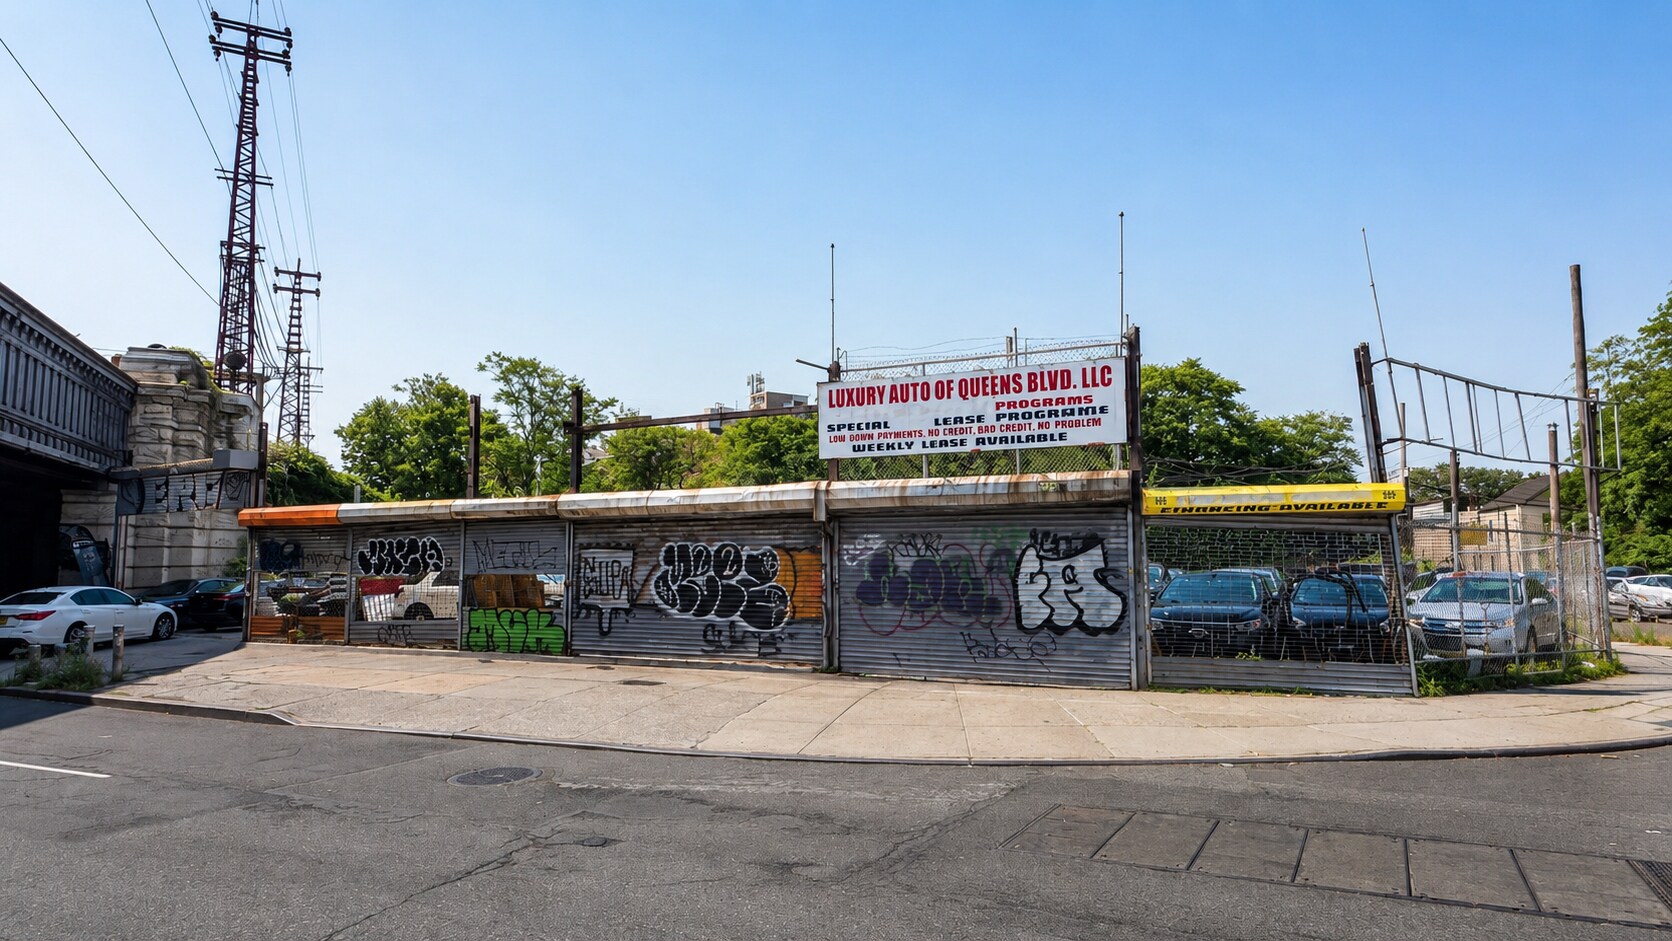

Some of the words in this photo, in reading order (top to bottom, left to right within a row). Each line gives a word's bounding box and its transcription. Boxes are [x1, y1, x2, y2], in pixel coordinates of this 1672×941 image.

[829, 385, 886, 408] LUXURY
[889, 381, 930, 404] AUTO
[935, 379, 954, 400] OF
[958, 373, 1023, 400] QUEENS
[1027, 369, 1077, 393] BLVD.
[1082, 365, 1112, 388] LLC
[995, 395, 1093, 410] PROGRAMS
[827, 421, 890, 432] SPECIAL
[934, 414, 985, 426] LEASE
[829, 435, 846, 443] LOW
[849, 433, 874, 442] DOWN
[928, 428, 940, 437] NO
[978, 425, 996, 434] BAD
[1038, 421, 1050, 430] NO
[1055, 417, 1102, 429] PROBLEM
[852, 441, 914, 452] WEEKLY
[922, 438, 968, 449] LEASE
[975, 432, 1068, 446] AVAILABLE
